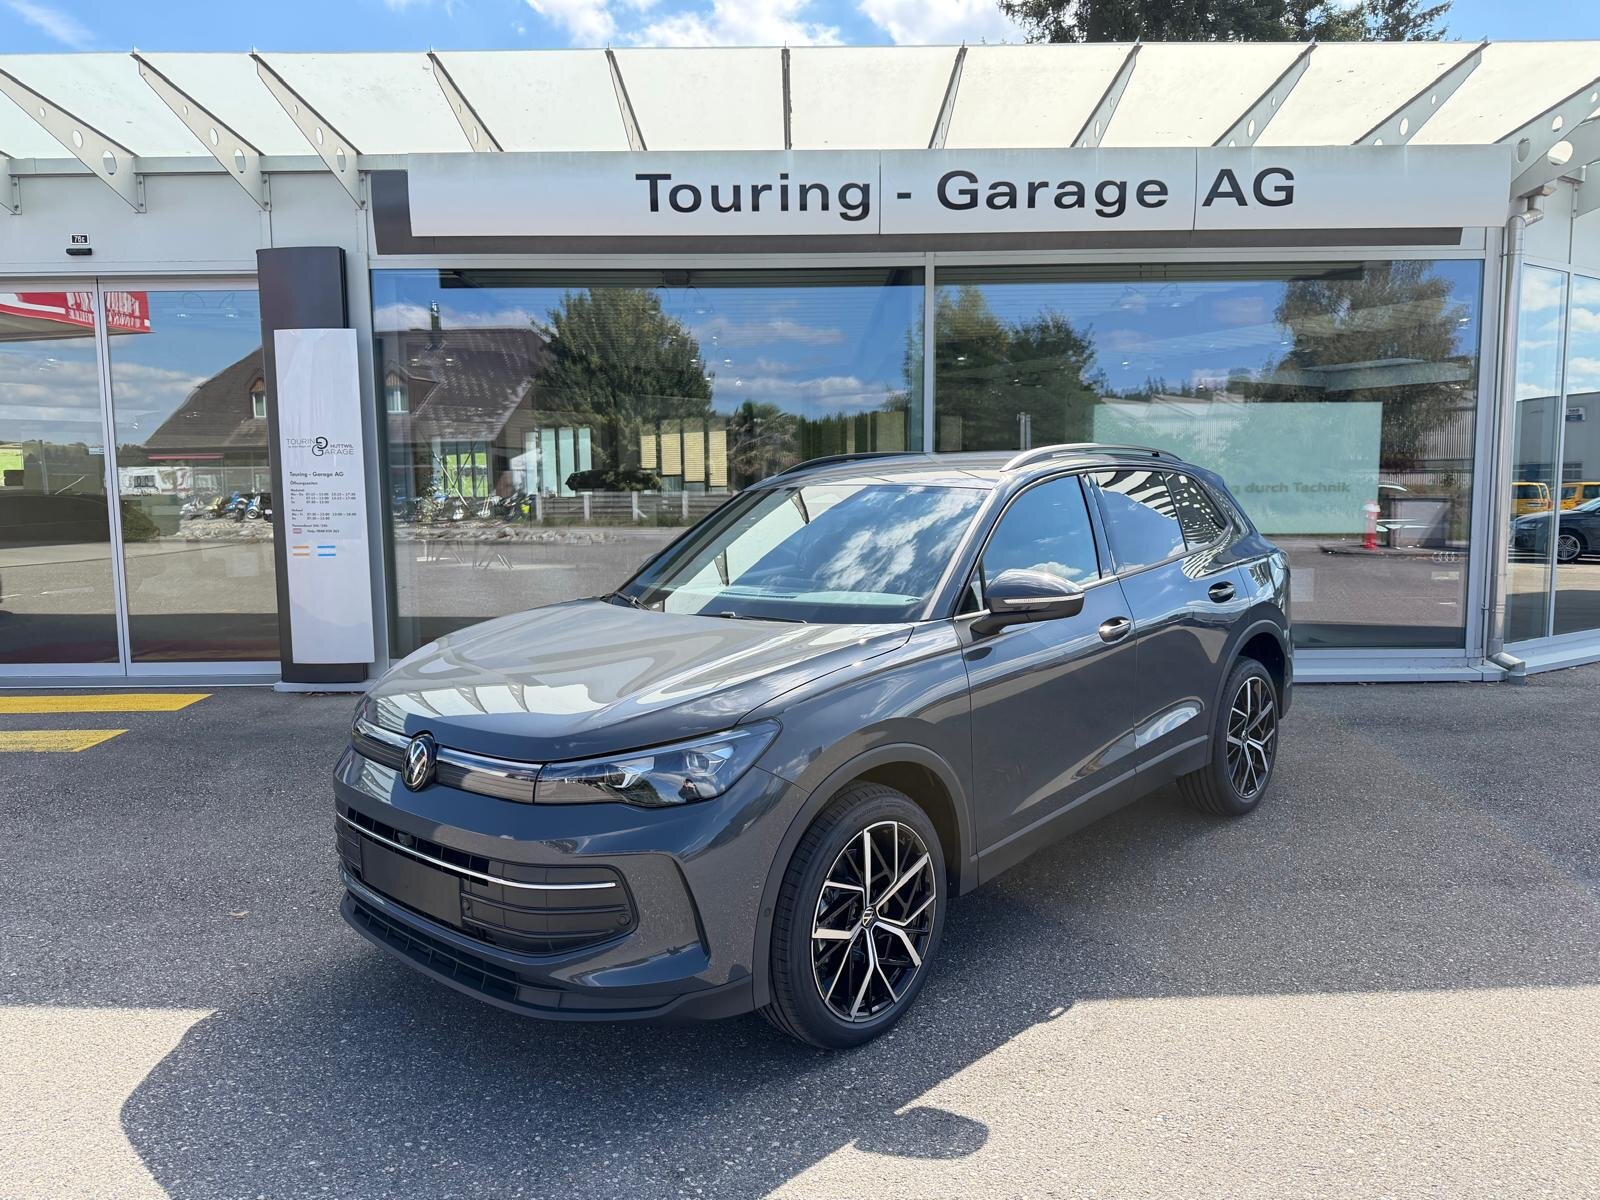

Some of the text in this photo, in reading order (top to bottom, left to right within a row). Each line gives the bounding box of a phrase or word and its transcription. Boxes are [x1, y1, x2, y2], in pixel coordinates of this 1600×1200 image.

[635, 173, 870, 221] Touring
[936, 170, 1168, 218] Garage
[1201, 168, 1294, 206] AG
[1245, 482, 1288, 493] durch
[1292, 482, 1350, 493] Technik
